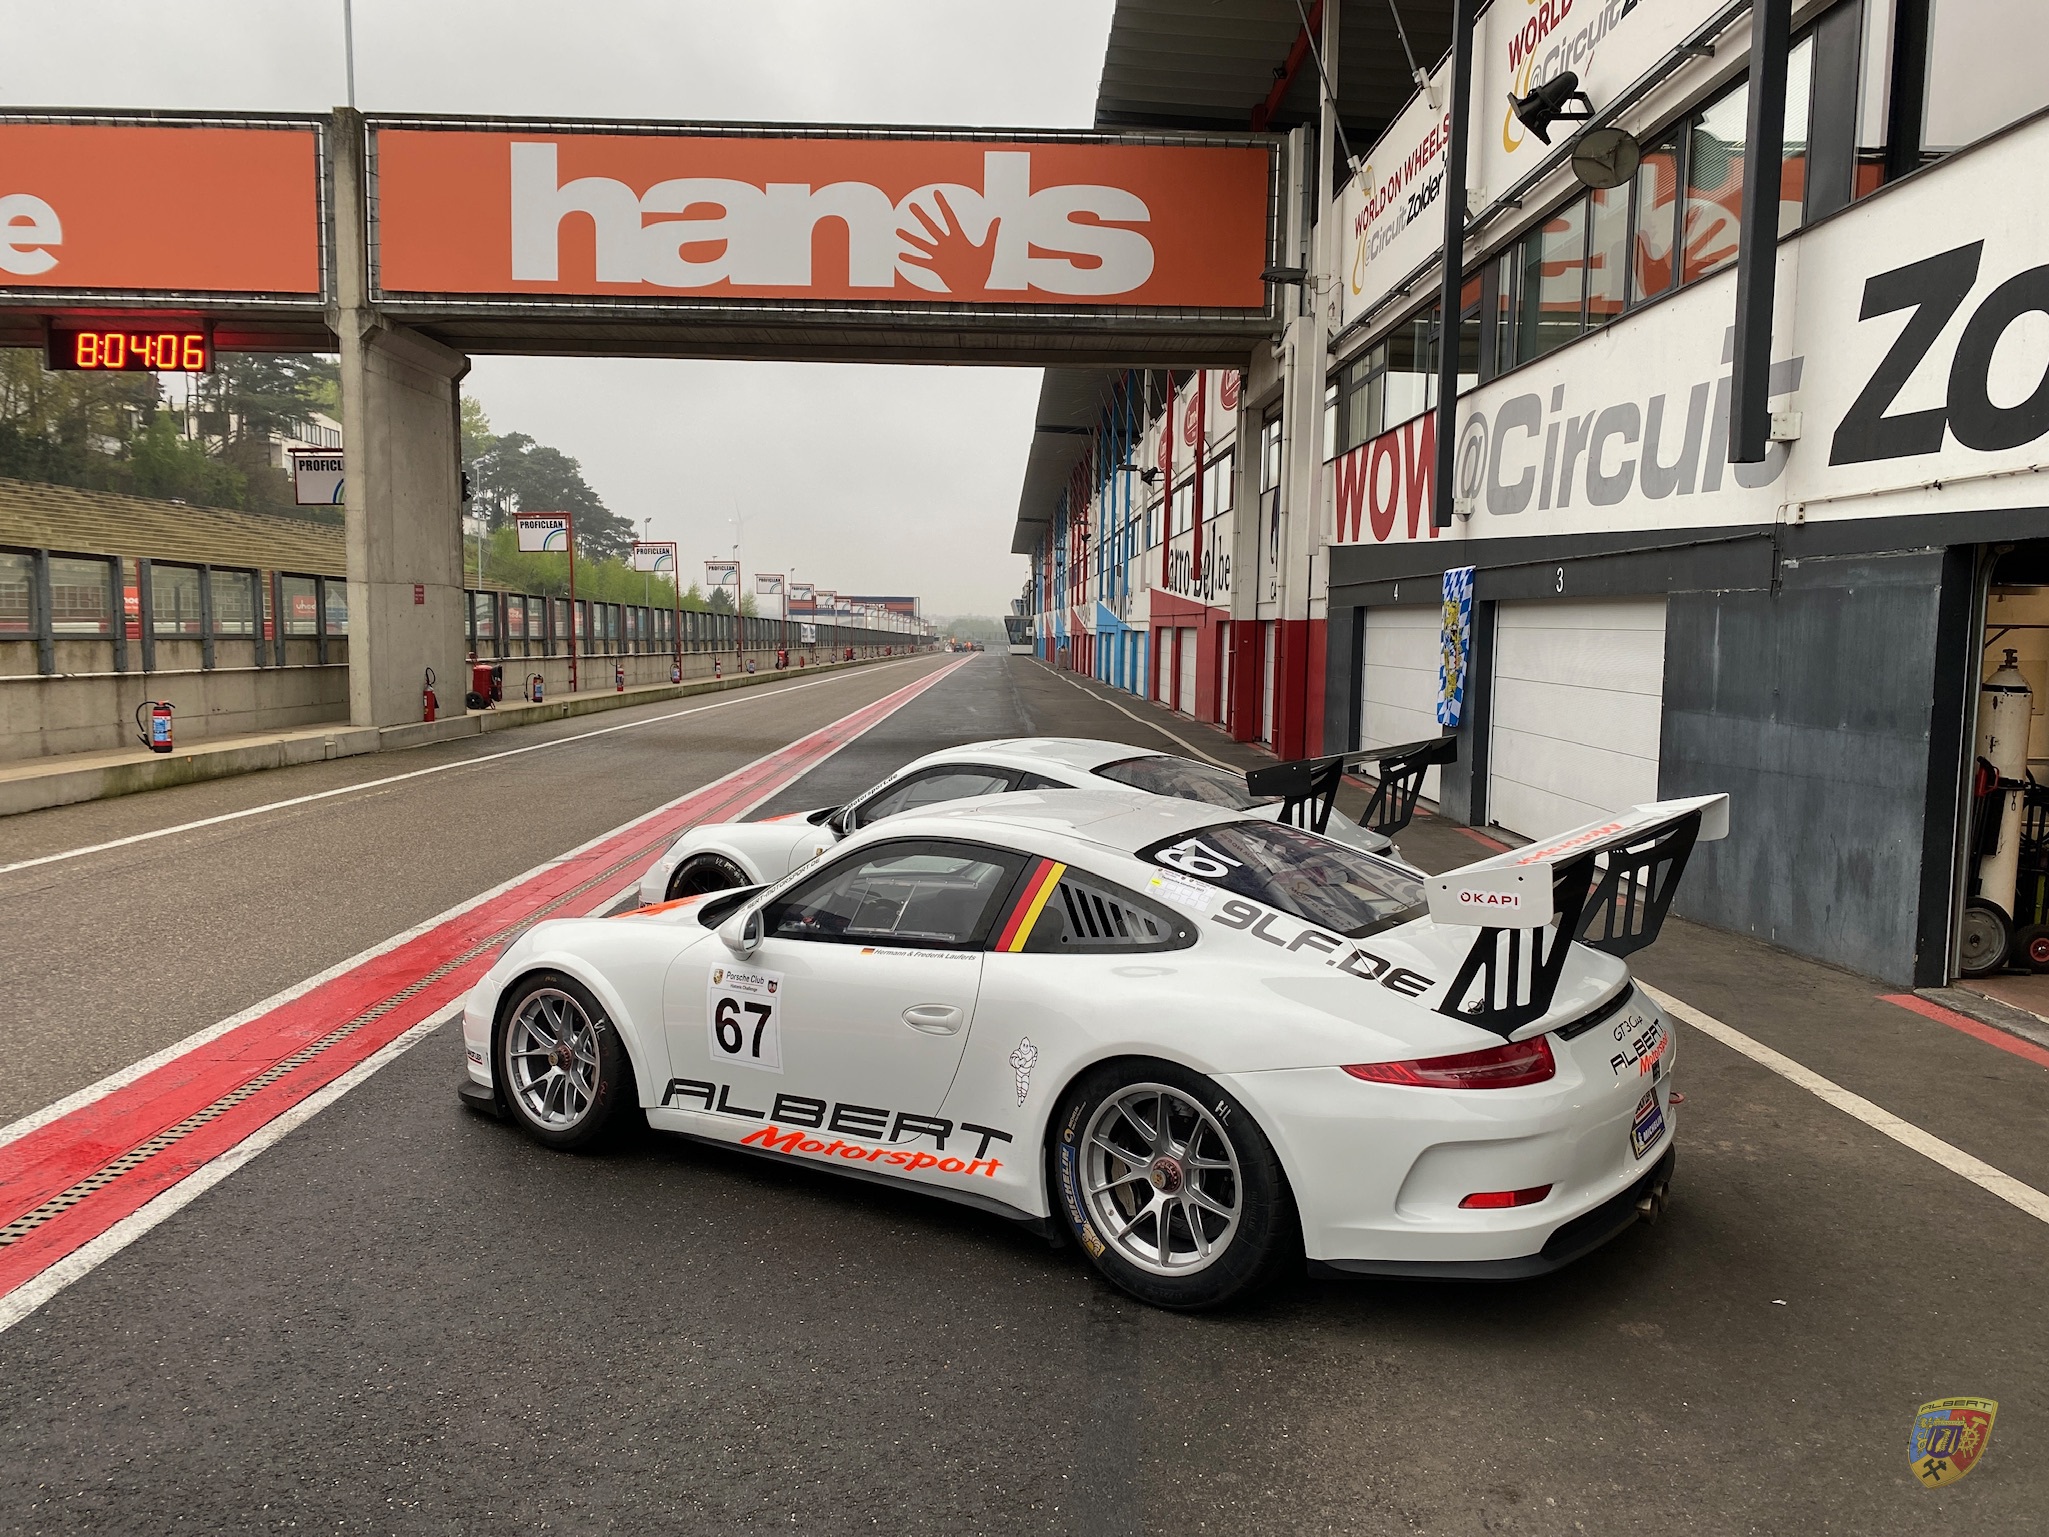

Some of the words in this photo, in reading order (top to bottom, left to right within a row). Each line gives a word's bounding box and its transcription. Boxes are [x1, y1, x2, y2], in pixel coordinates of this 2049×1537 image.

[1354, 186, 1386, 240] WORLD
[1387, 166, 1402, 204] ON
[1404, 113, 1450, 186] WHEELS
[0, 193, 63, 275] e
[510, 141, 1155, 296] hands
[76, 332, 204, 370] 8:04:06
[298, 459, 344, 472] PROFICL
[1335, 411, 1441, 543] WOW
[519, 520, 564, 530] PROFICLEAN
[636, 547, 670, 555] PROFICLEAN
[1168, 521, 1231, 600] arroel.be
[1393, 583, 1399, 601] 4
[1555, 566, 1565, 593] 3
[1154, 836, 1244, 878] 67
[1460, 891, 1518, 906] OKAPI
[874, 949, 907, 957] Hermann
[945, 953, 977, 961] Lauferts
[1211, 899, 1436, 998] 9LF.DE
[726, 971, 750, 983] Porsche
[750, 974, 765, 985] Club
[715, 997, 772, 1058] 67
[1609, 1018, 1665, 1076] ALBERT
[660, 1078, 1013, 1159] ALBERT
[1214, 1099, 1232, 1127] HL
[740, 1125, 1004, 1178] Motorsport
[1061, 1148, 1083, 1224] MICHELIN
